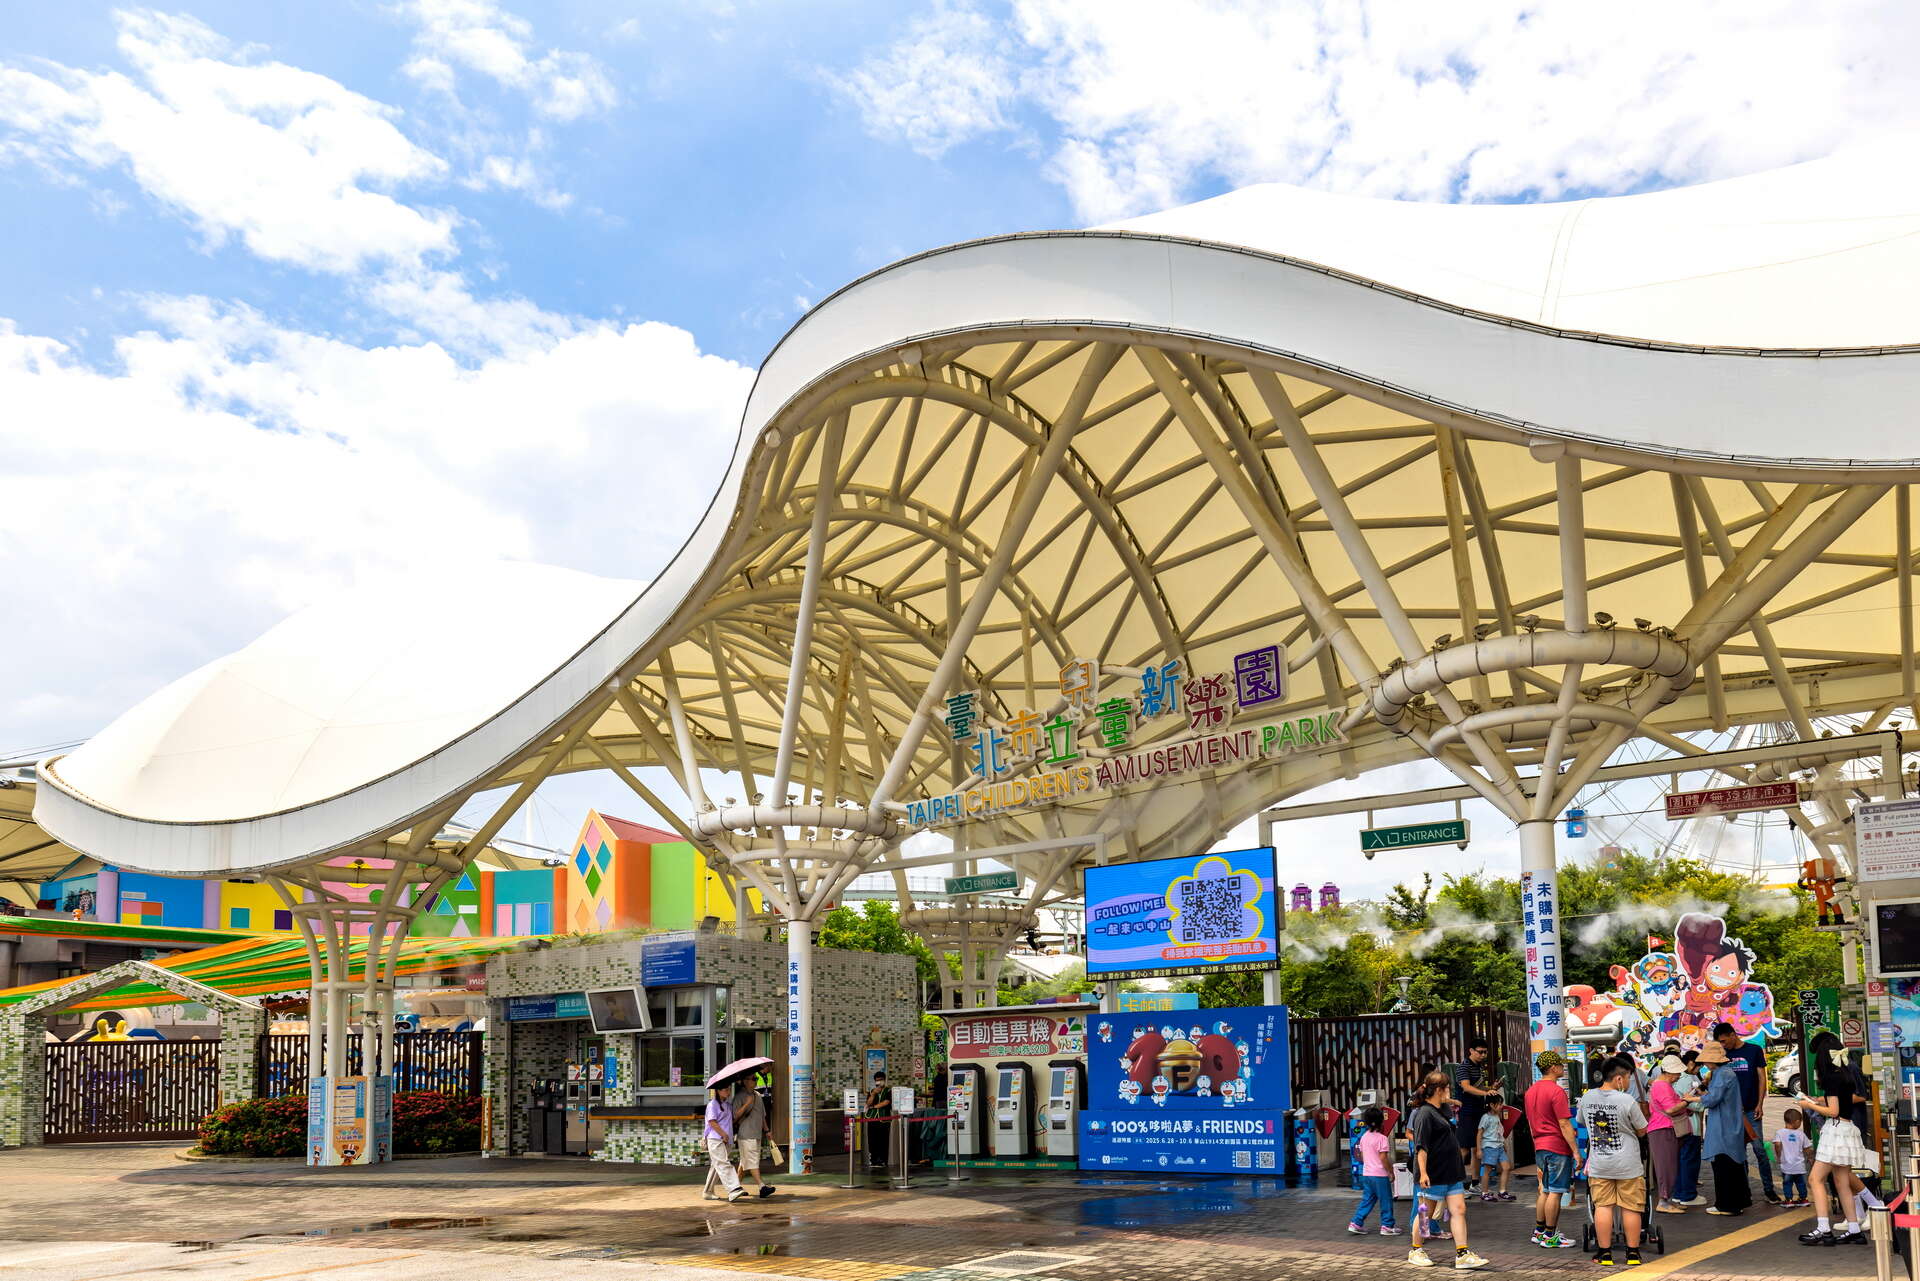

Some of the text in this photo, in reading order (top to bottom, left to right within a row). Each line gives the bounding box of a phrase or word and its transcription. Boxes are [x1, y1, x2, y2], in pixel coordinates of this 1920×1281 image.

[945, 644, 1283, 778] 臺北市立兒童新樂園
[906, 709, 1343, 826] TAIPEI CHILDREN'S AMUSEMENT PARK
[1370, 827, 1458, 848] 入口 ENTRANCE
[951, 875, 1015, 892] 入口 ENTRANCE
[1094, 896, 1166, 921] FOLLOW ME!
[1094, 919, 1172, 937] 一起來心中山
[1523, 893, 1541, 1018] 門票請刷卡入園
[1537, 882, 1562, 1026] 未購買一日樂Fun券
[954, 1018, 1050, 1045] 自動售票機
[1111, 1120, 1148, 1134] 100%
[1149, 1119, 1193, 1134] 哆啦A夢
[1202, 1119, 1265, 1134] FRIENDS
